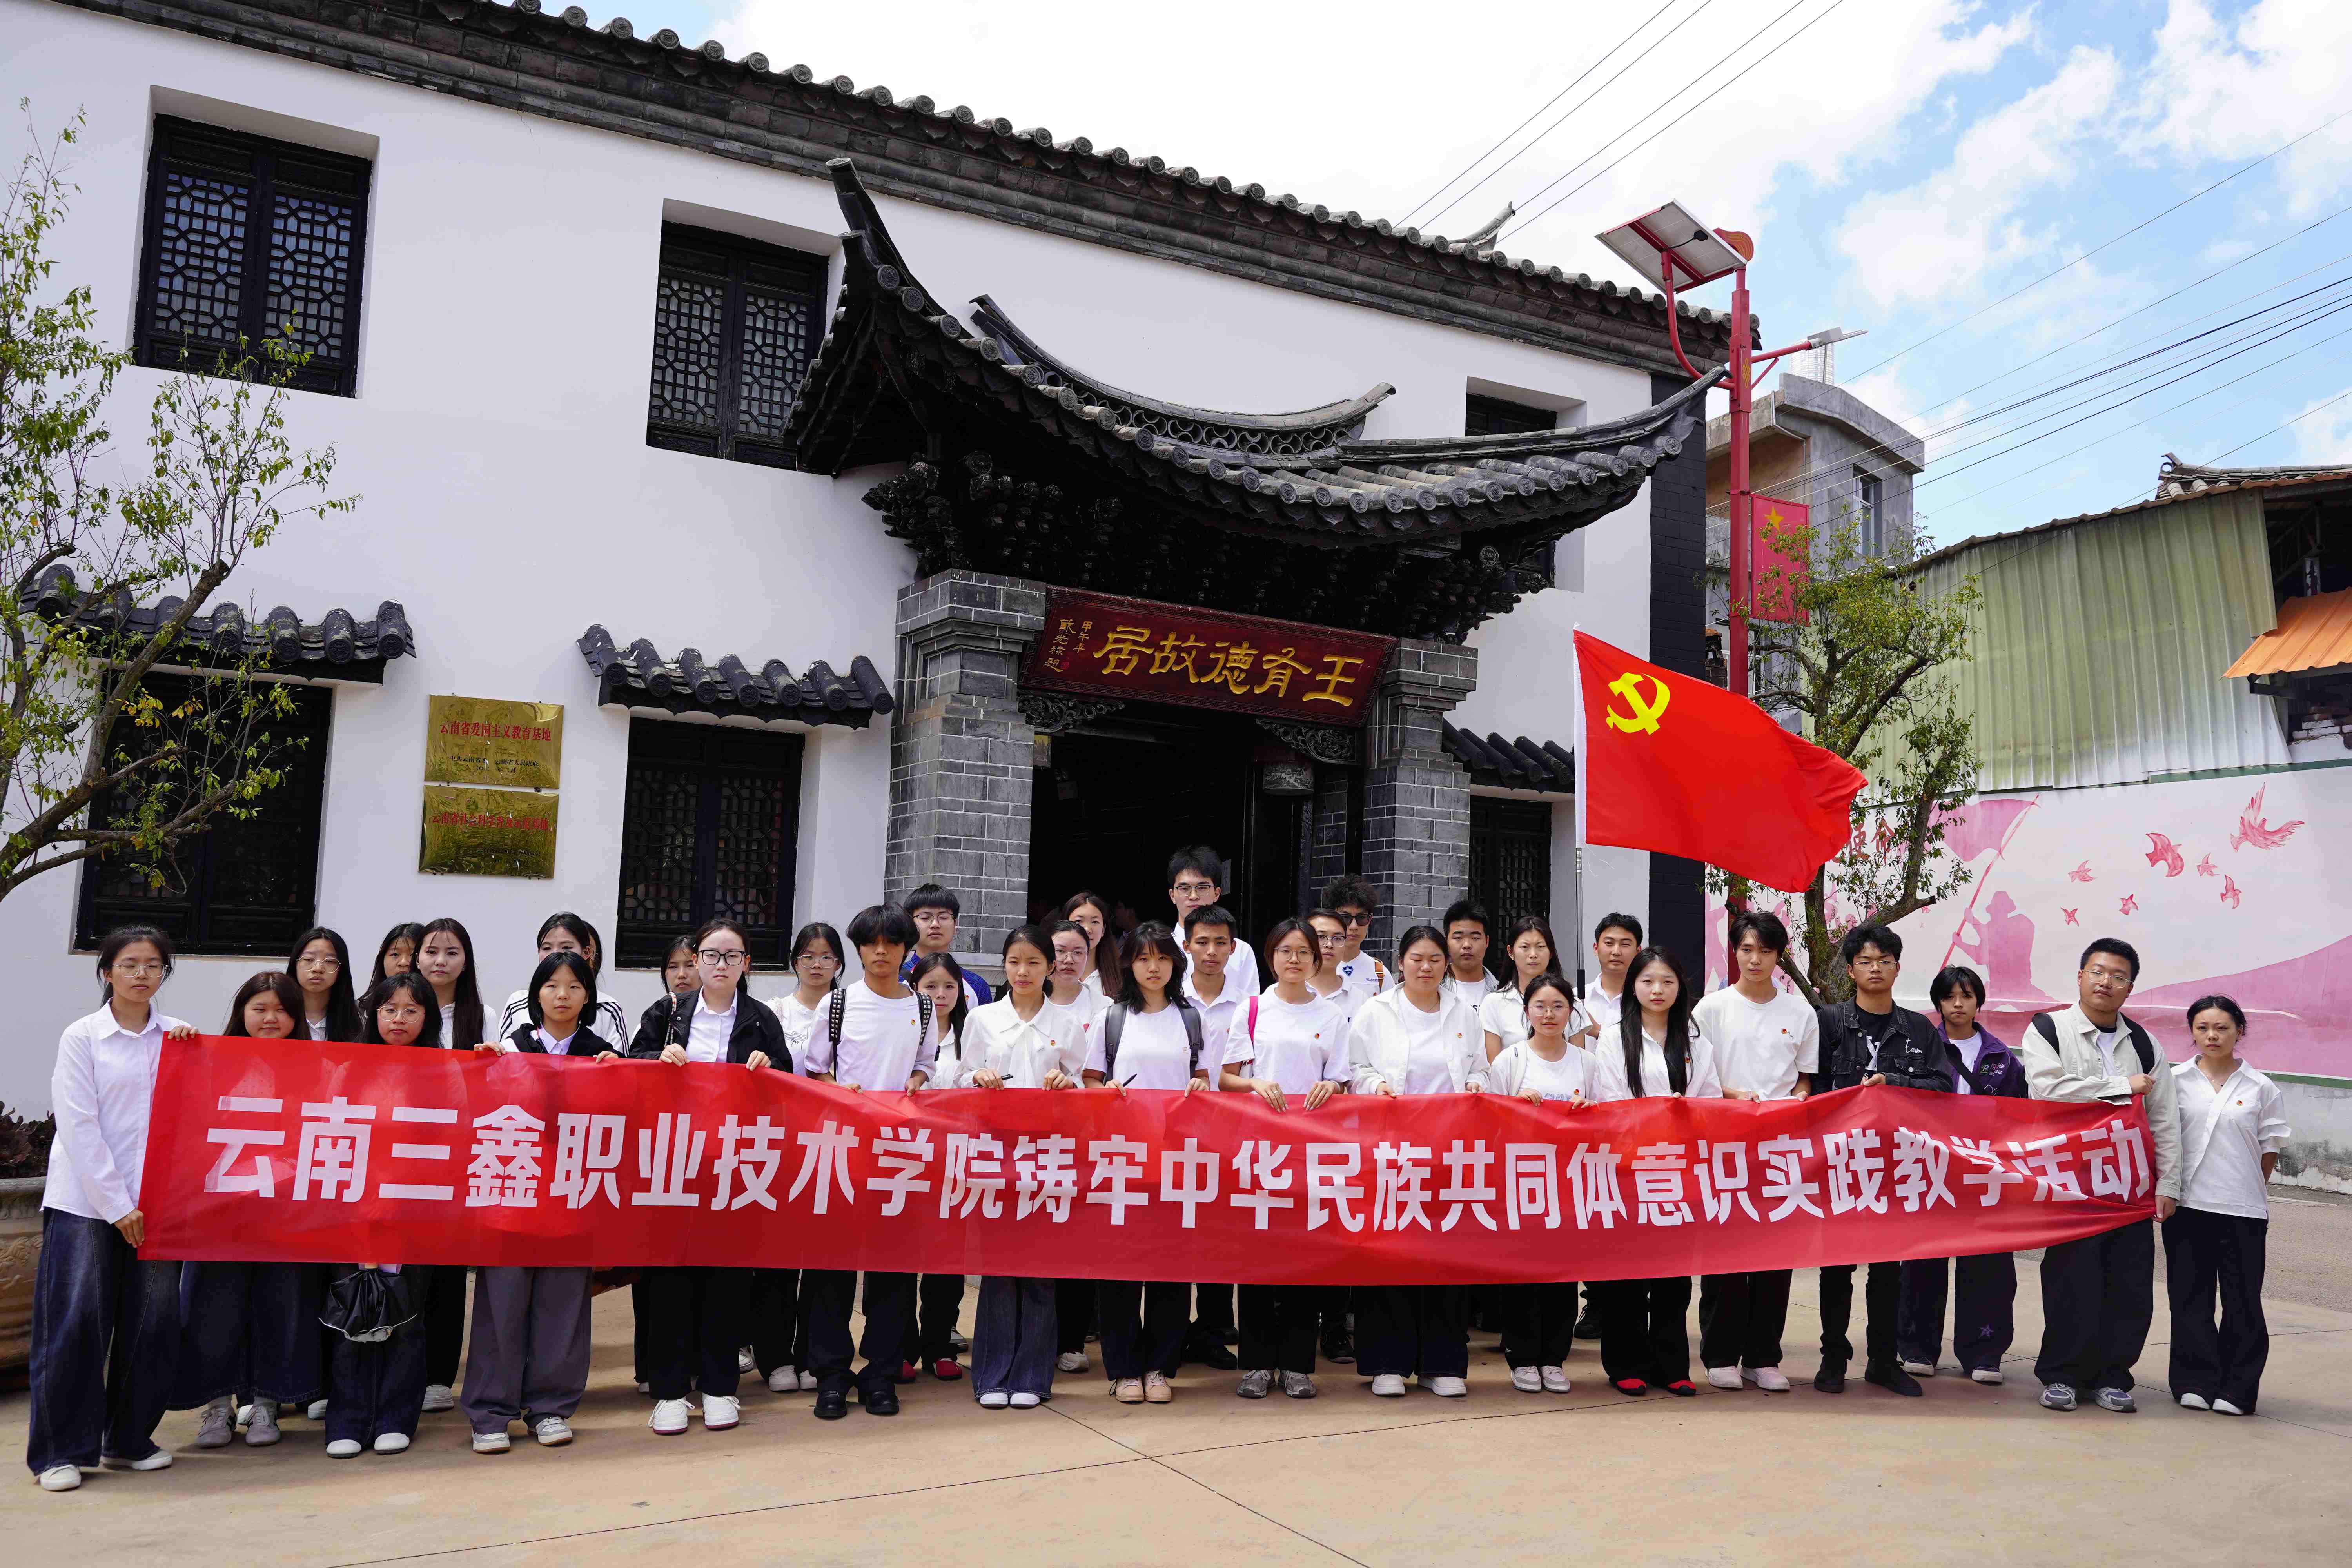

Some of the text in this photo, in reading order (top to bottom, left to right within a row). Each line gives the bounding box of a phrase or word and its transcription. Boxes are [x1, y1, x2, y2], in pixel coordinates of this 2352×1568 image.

[1073, 621, 1093, 653] 甲午年
[439, 721, 551, 741] 云南省爱国主义教育基地
[205, 1096, 2151, 1232] 云南三鑫职业技术学院铸牢中华民族共同体意识实践教学活动
